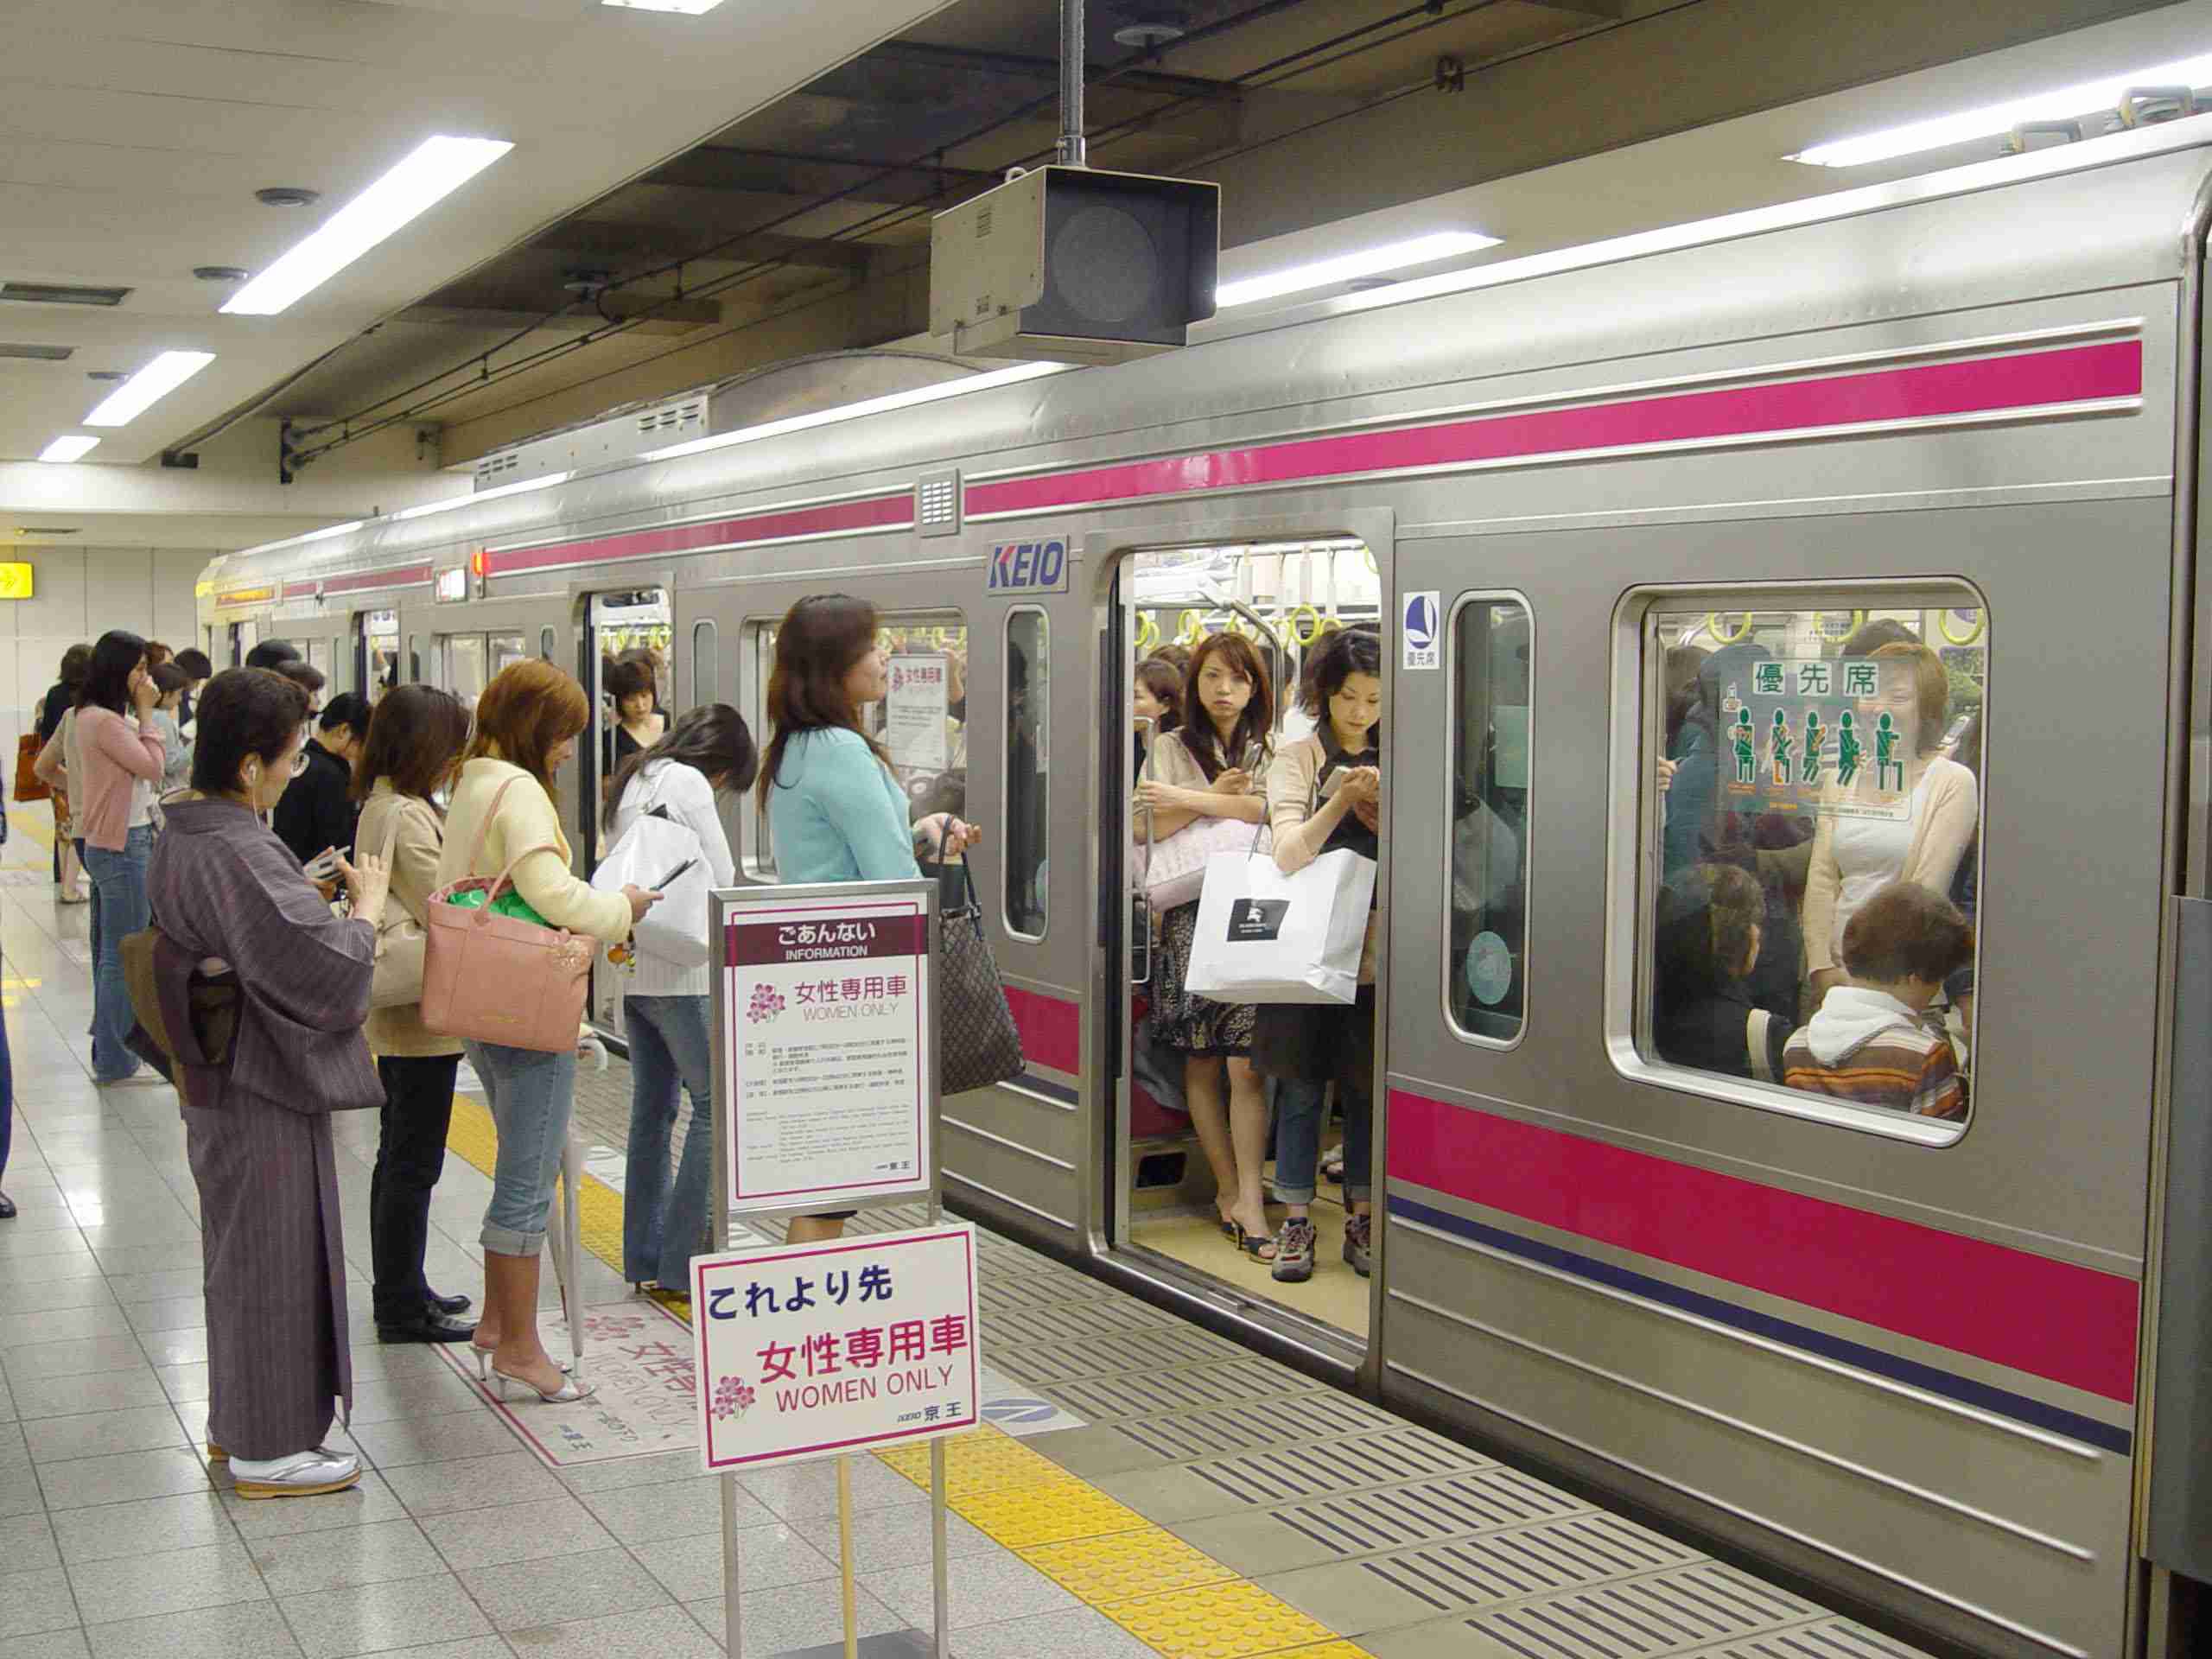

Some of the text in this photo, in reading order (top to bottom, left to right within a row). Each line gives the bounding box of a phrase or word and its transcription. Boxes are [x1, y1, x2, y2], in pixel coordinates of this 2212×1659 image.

[988, 542, 1064, 588] KEIO
[1755, 663, 1877, 695] 優先席
[779, 922, 875, 945] ごあんない
[785, 945, 868, 961] INFORMATION
[794, 976, 907, 1005] 女性専用車
[804, 1001, 899, 1021] WOMEN ONLY
[709, 1264, 893, 1319] これより先
[756, 1313, 969, 1384] 女性専用車
[776, 1364, 953, 1412] WOMEN ONLY
